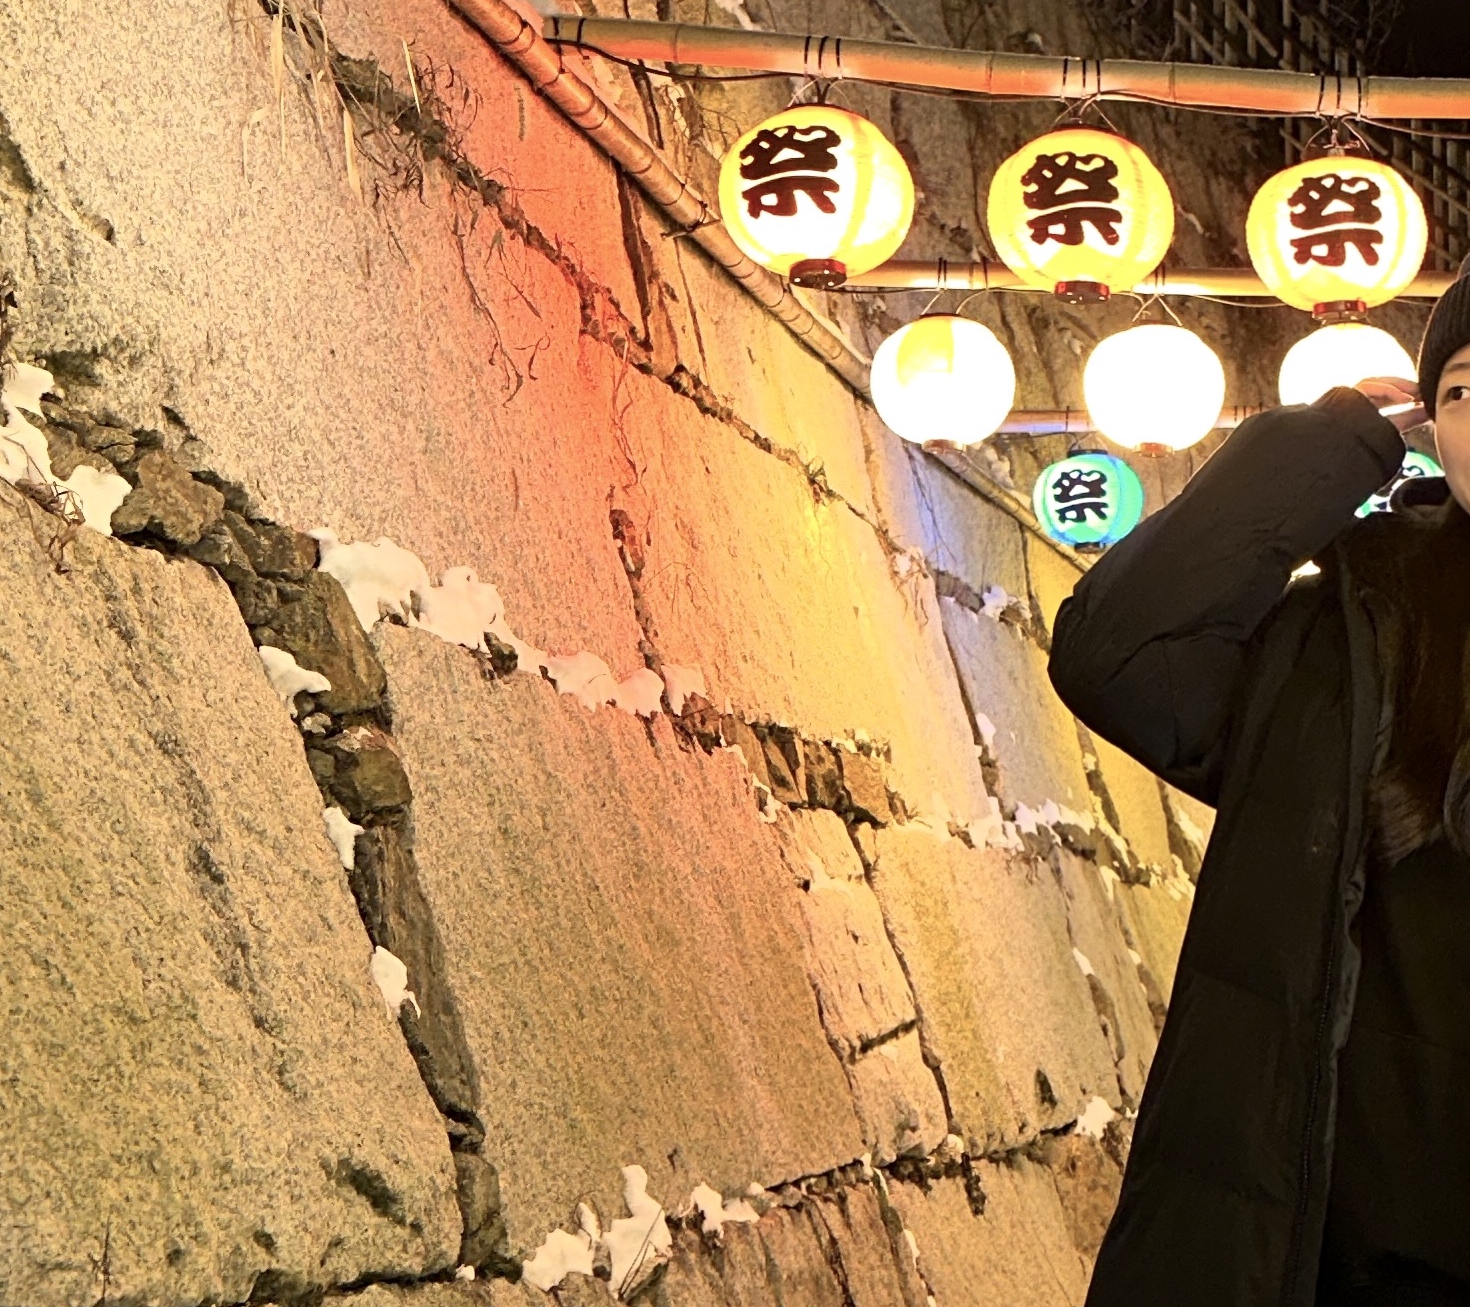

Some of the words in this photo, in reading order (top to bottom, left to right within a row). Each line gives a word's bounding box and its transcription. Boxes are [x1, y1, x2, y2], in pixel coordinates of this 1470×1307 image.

[738, 124, 843, 219] 祭
[1020, 150, 1123, 246] 祭
[1286, 173, 1384, 266] 祭
[1052, 468, 1110, 524] 祭
